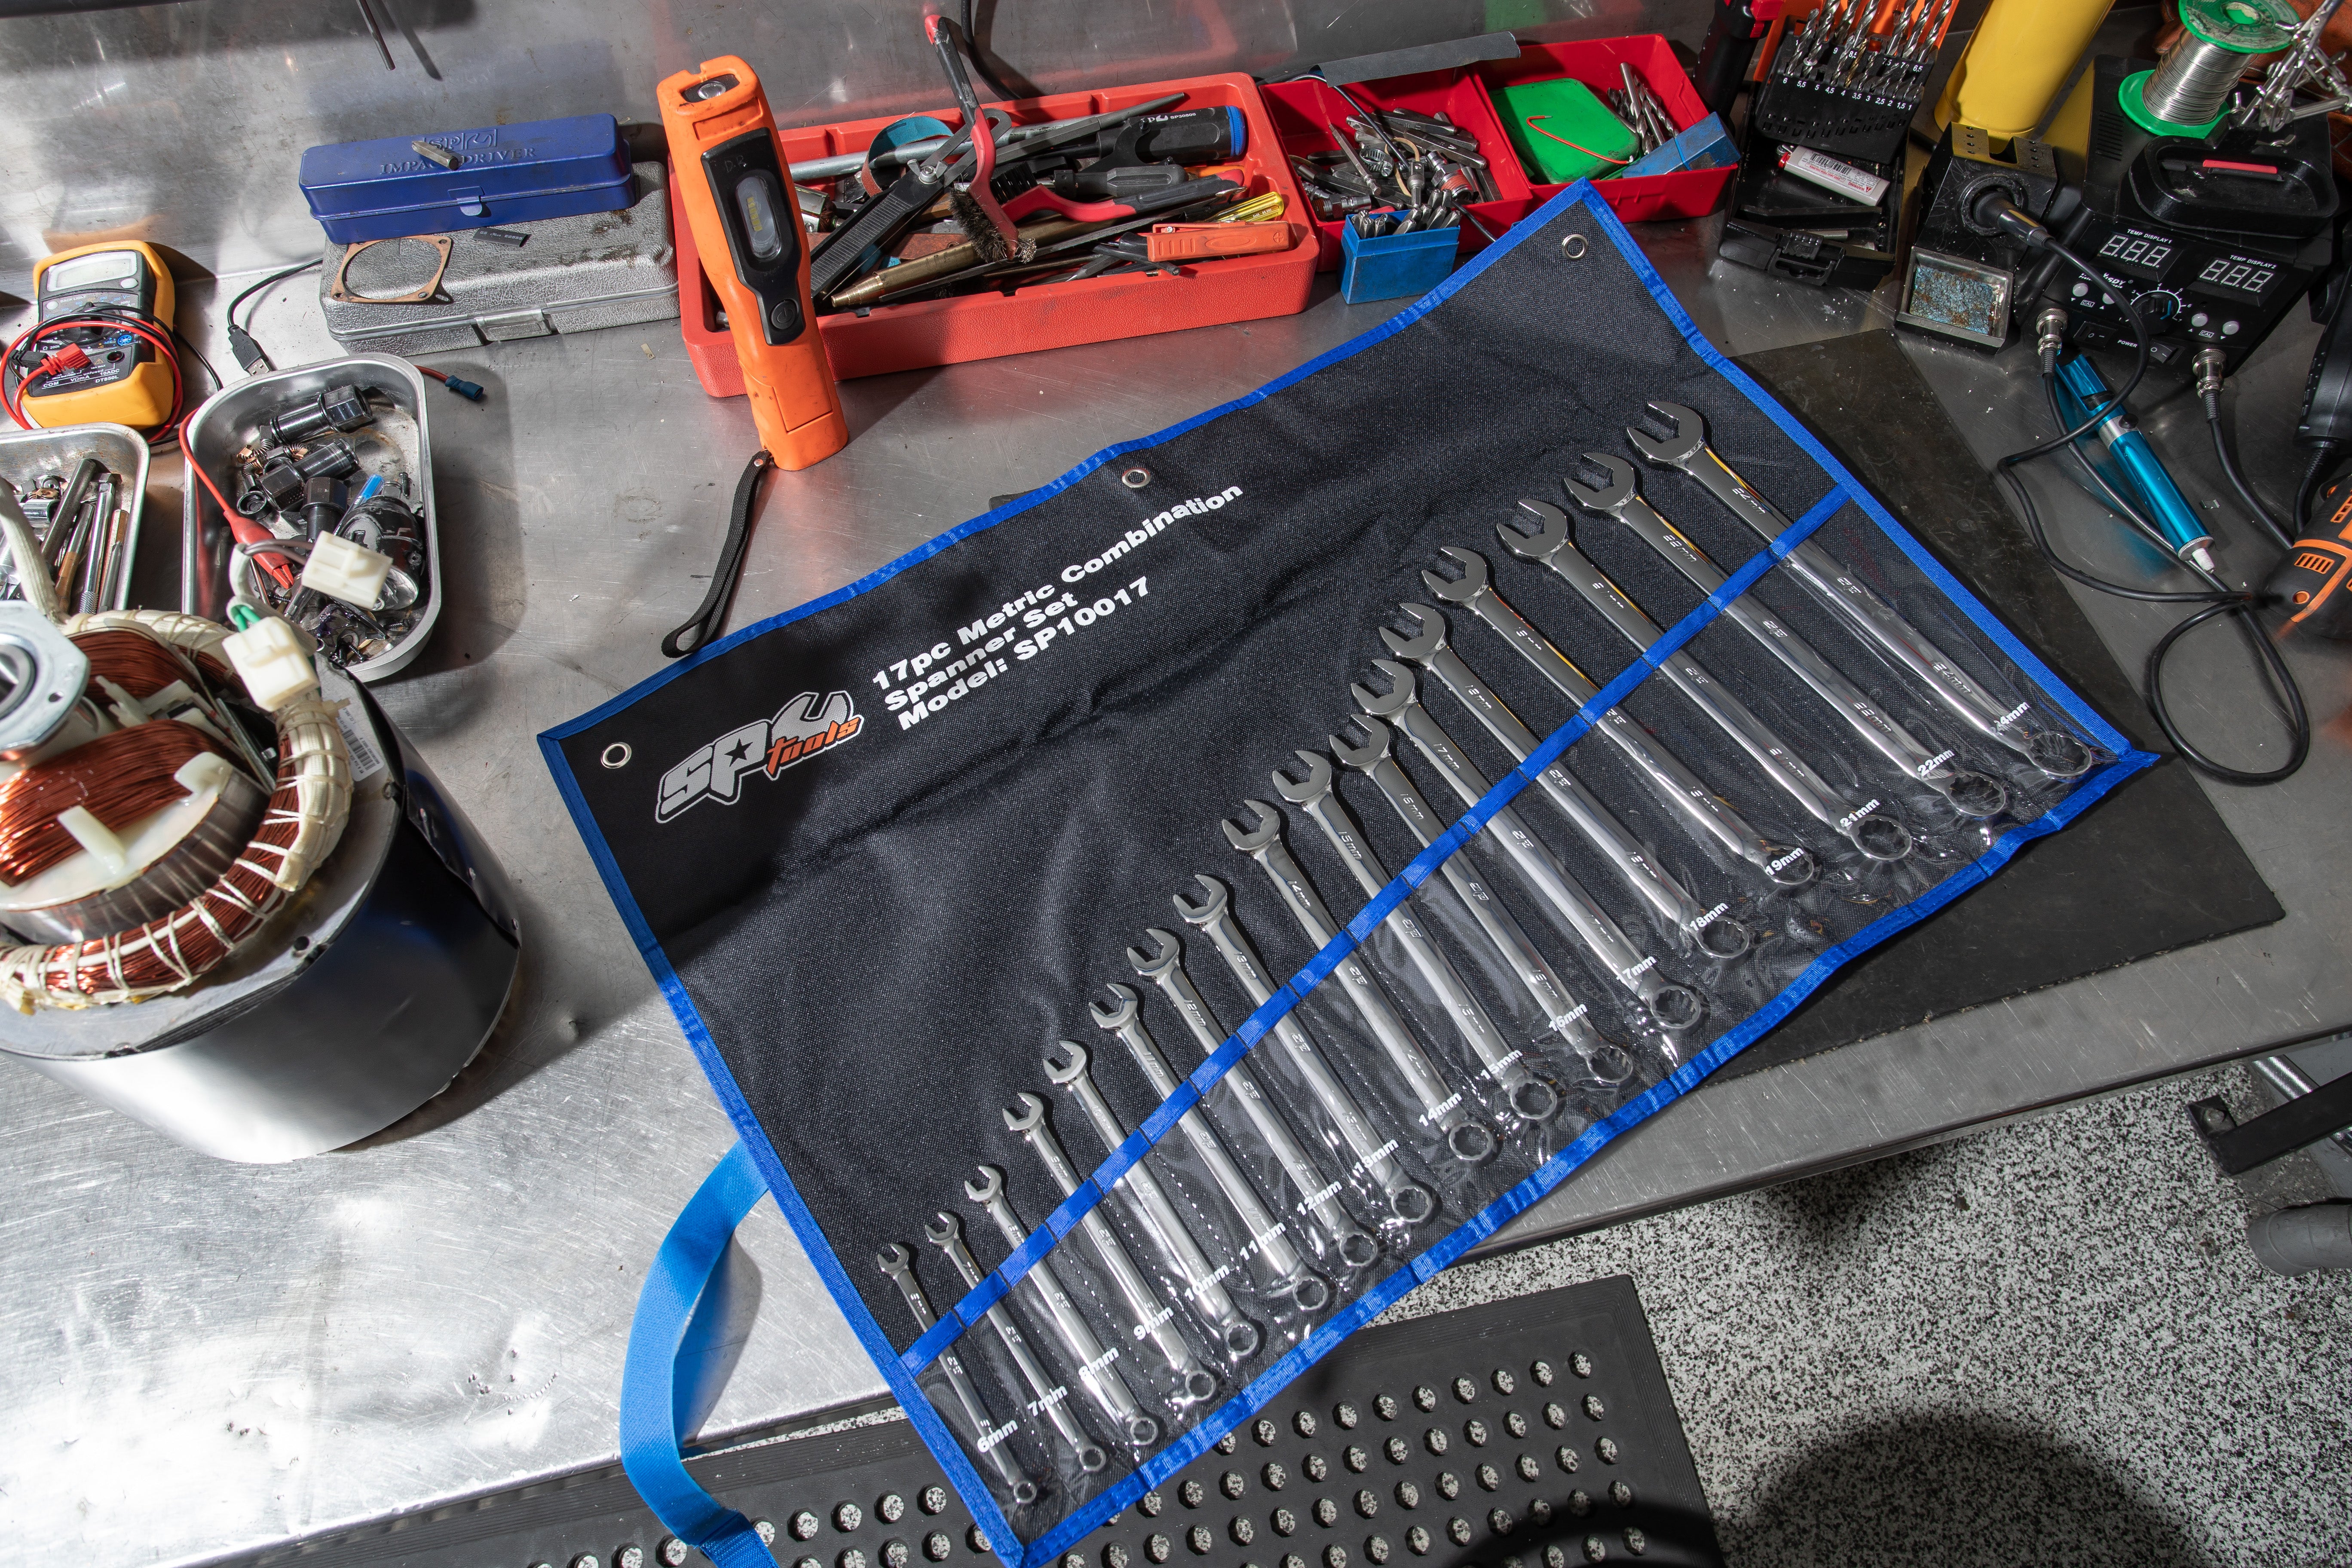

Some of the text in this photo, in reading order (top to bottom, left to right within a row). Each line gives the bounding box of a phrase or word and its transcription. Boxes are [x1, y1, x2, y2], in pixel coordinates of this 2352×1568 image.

[1882, 58, 1892, 66] 7,5
[1912, 64, 1923, 73] 6,5
[1796, 80, 1807, 88] 5,5
[1825, 86, 1835, 94] 4,5
[1852, 92, 1862, 100] 3,5
[1897, 102, 1906, 110] 1,5
[461, 147, 536, 164] DRIVER
[2127, 229, 2142, 238] TEMP
[2143, 233, 2168, 244] DISPLAY
[2230, 254, 2245, 263] TEMP
[2247, 259, 2272, 269] DISPLAY
[2117, 340, 2138, 348] POWER
[95, 375, 119, 383] DT850L
[1662, 534, 1697, 563] 22mm
[872, 486, 1243, 690] 17pc Metric Combination
[885, 591, 1078, 711] Spanner Set
[898, 576, 1150, 731] Model: SP10017
[1990, 701, 2030, 736] 24mm
[766, 717, 861, 775] tools
[1433, 743, 1460, 771] 17mm
[1917, 748, 1954, 778] 22mm
[1839, 798, 1880, 829] 21mm
[1338, 830, 1362, 860] 15mm
[1764, 846, 1804, 876] 19mm
[1689, 901, 1730, 931] 18mm
[1616, 955, 1657, 985] 17mm
[1183, 999, 1206, 1027] 12mm
[1548, 1003, 1587, 1031] 16mm
[1143, 1052, 1164, 1078] 11mm
[1480, 1048, 1522, 1079] 15mm
[1418, 1093, 1463, 1127] 14mm
[1355, 1139, 1399, 1174] 13mm
[1296, 1181, 1342, 1215] 12mm
[1239, 1221, 1286, 1260] 11mm
[1184, 1265, 1230, 1302] 10mm
[1133, 1305, 1174, 1341] 9mm
[1078, 1346, 1120, 1383] 8mm
[1028, 1384, 1067, 1415] 7mm
[977, 1420, 1018, 1453] 6mm
